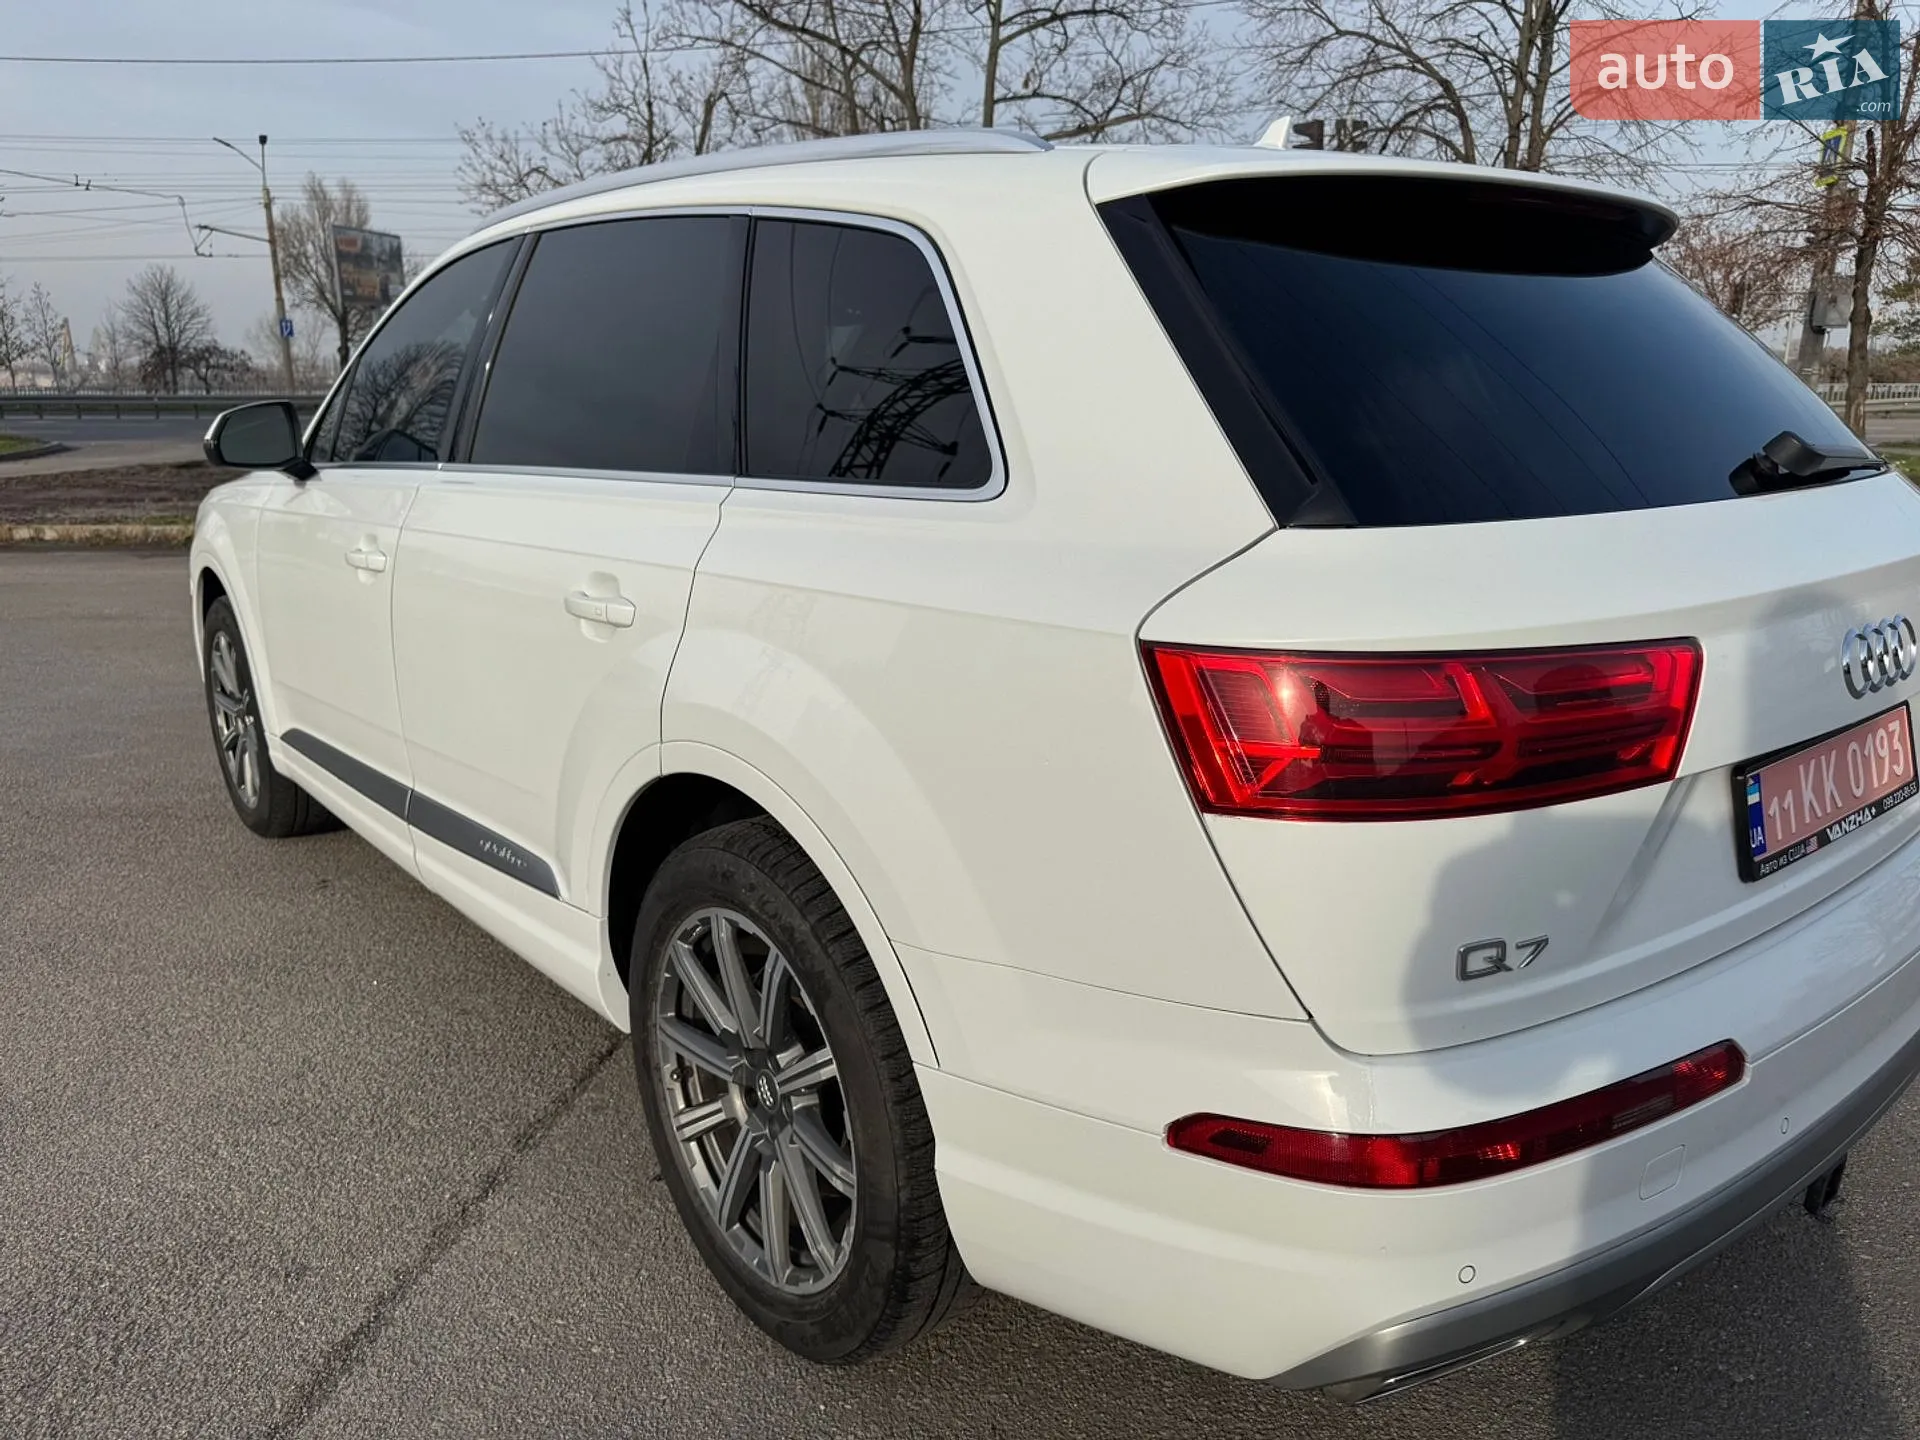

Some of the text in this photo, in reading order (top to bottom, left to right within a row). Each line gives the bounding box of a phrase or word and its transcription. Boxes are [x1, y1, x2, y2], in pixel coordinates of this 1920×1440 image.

[1768, 720, 1905, 840] 11 KK 0193
[1750, 826, 1765, 848] UA
[1456, 934, 1549, 981] Q7
